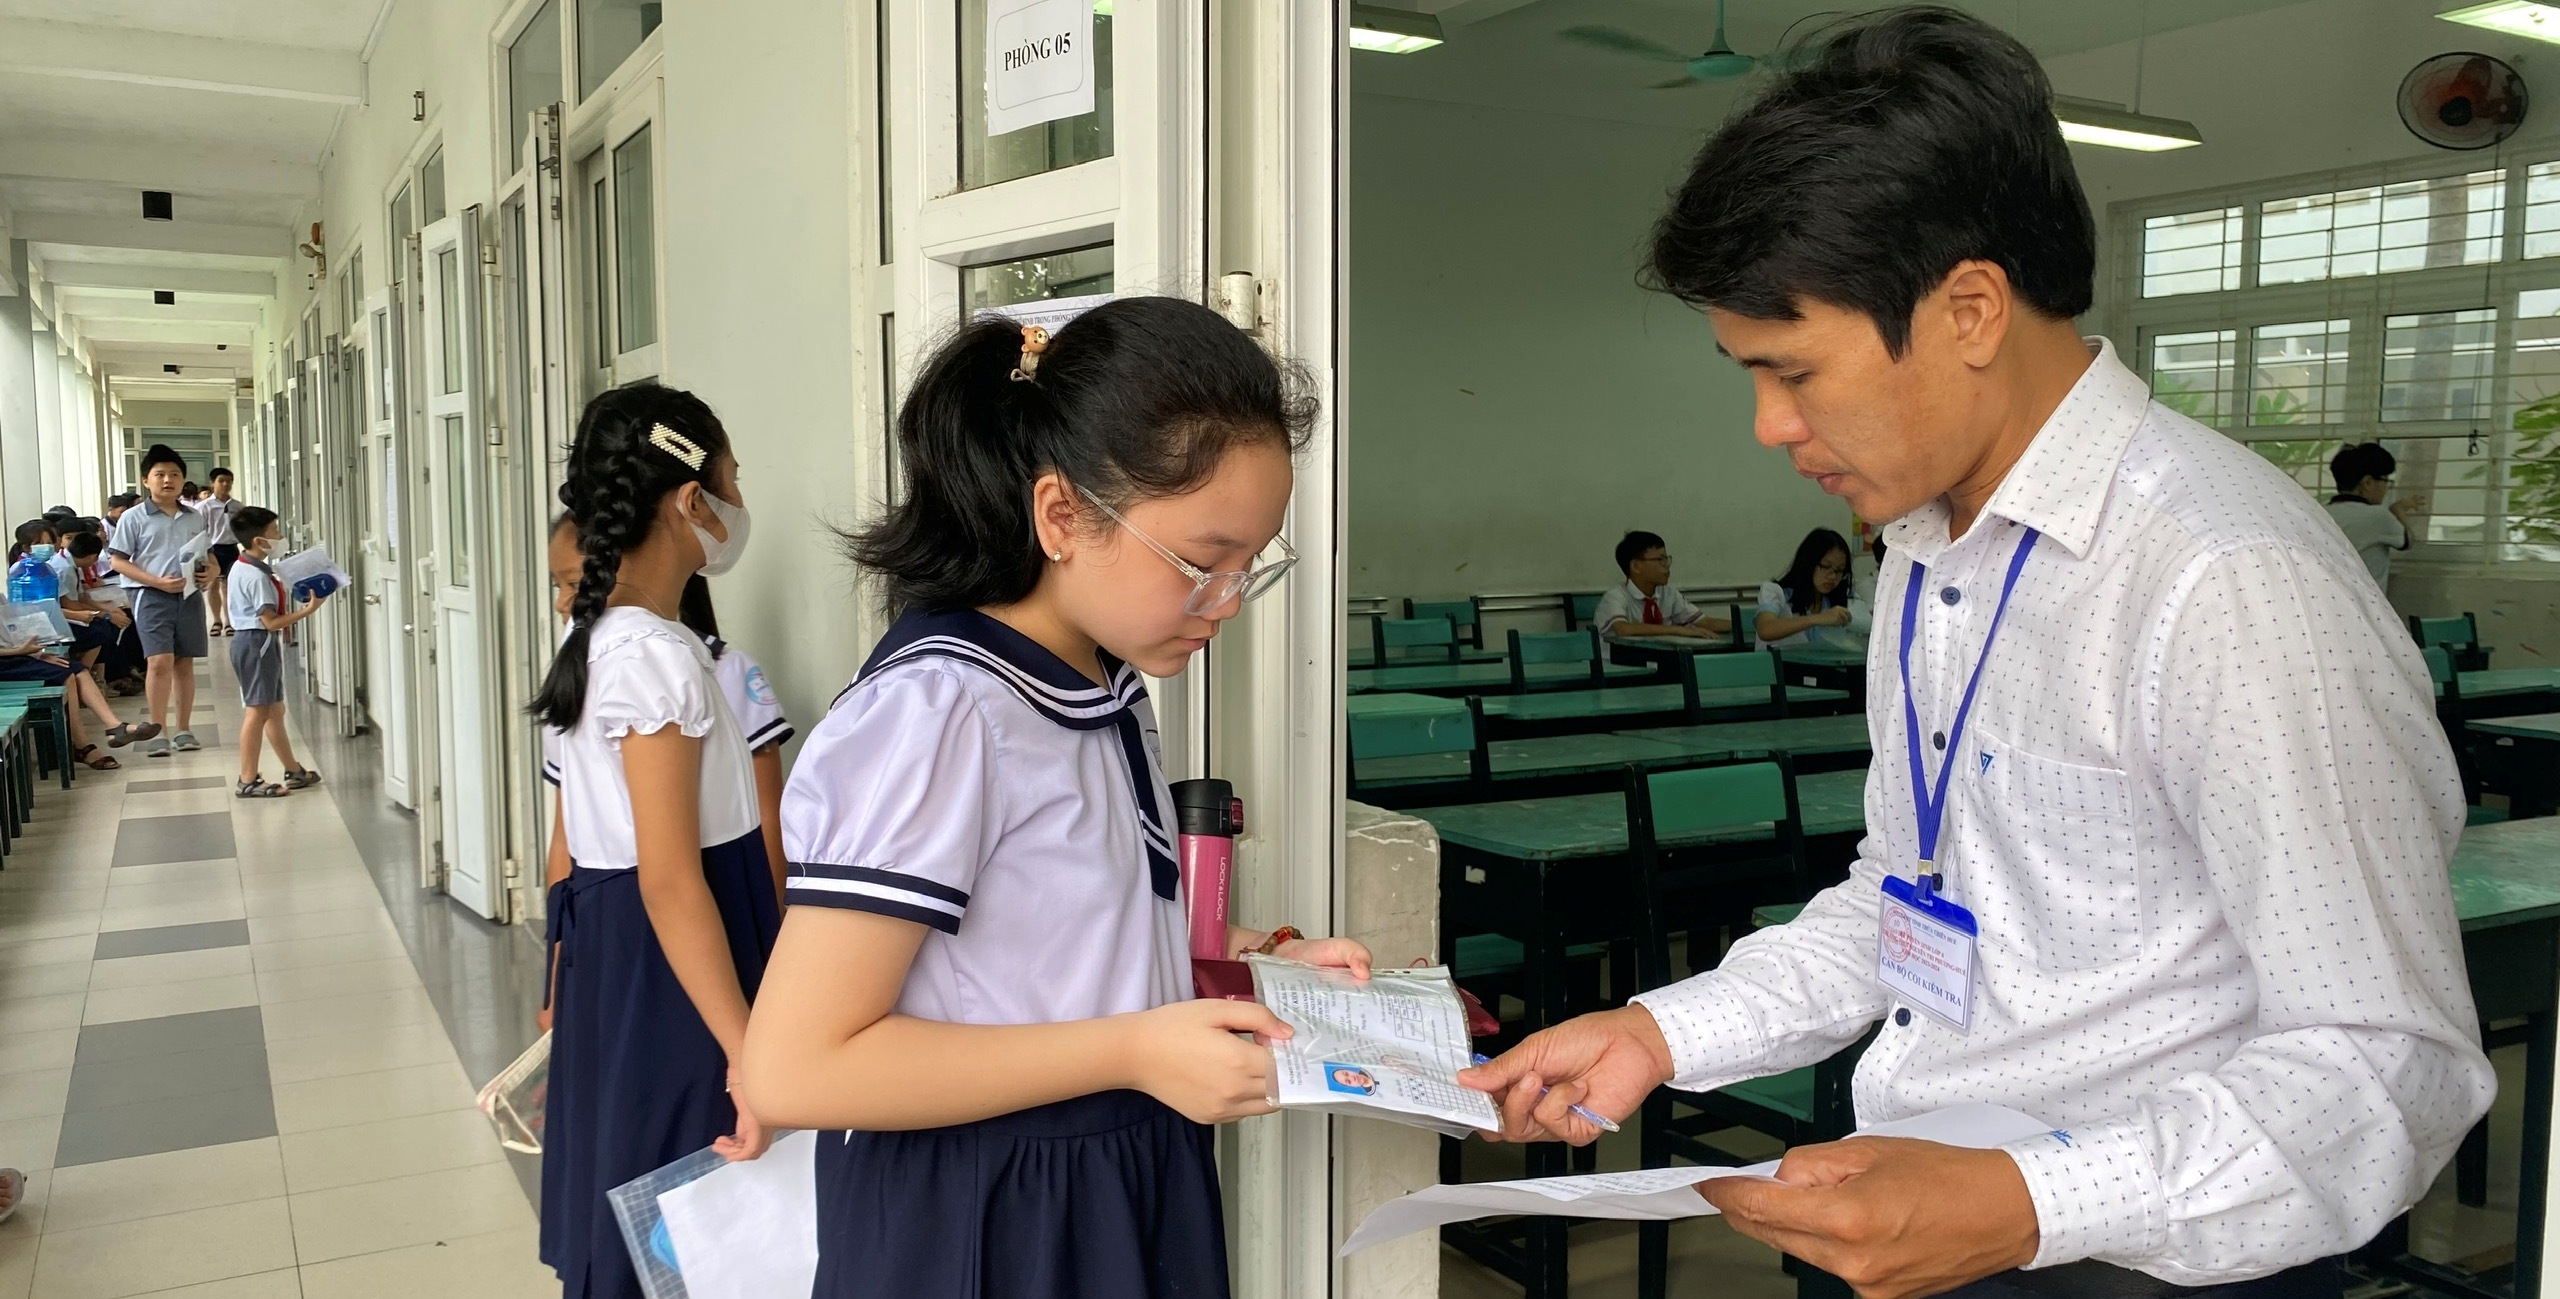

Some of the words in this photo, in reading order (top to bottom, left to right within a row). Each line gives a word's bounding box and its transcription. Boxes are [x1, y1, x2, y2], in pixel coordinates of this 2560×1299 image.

[1005, 38, 1051, 71] PHÒNG
[1055, 32, 1071, 55] 05
[1216, 856, 1227, 922] LOCK&LOCK
[1907, 970, 1921, 986] COI
[1944, 990, 1962, 1007] TRA
